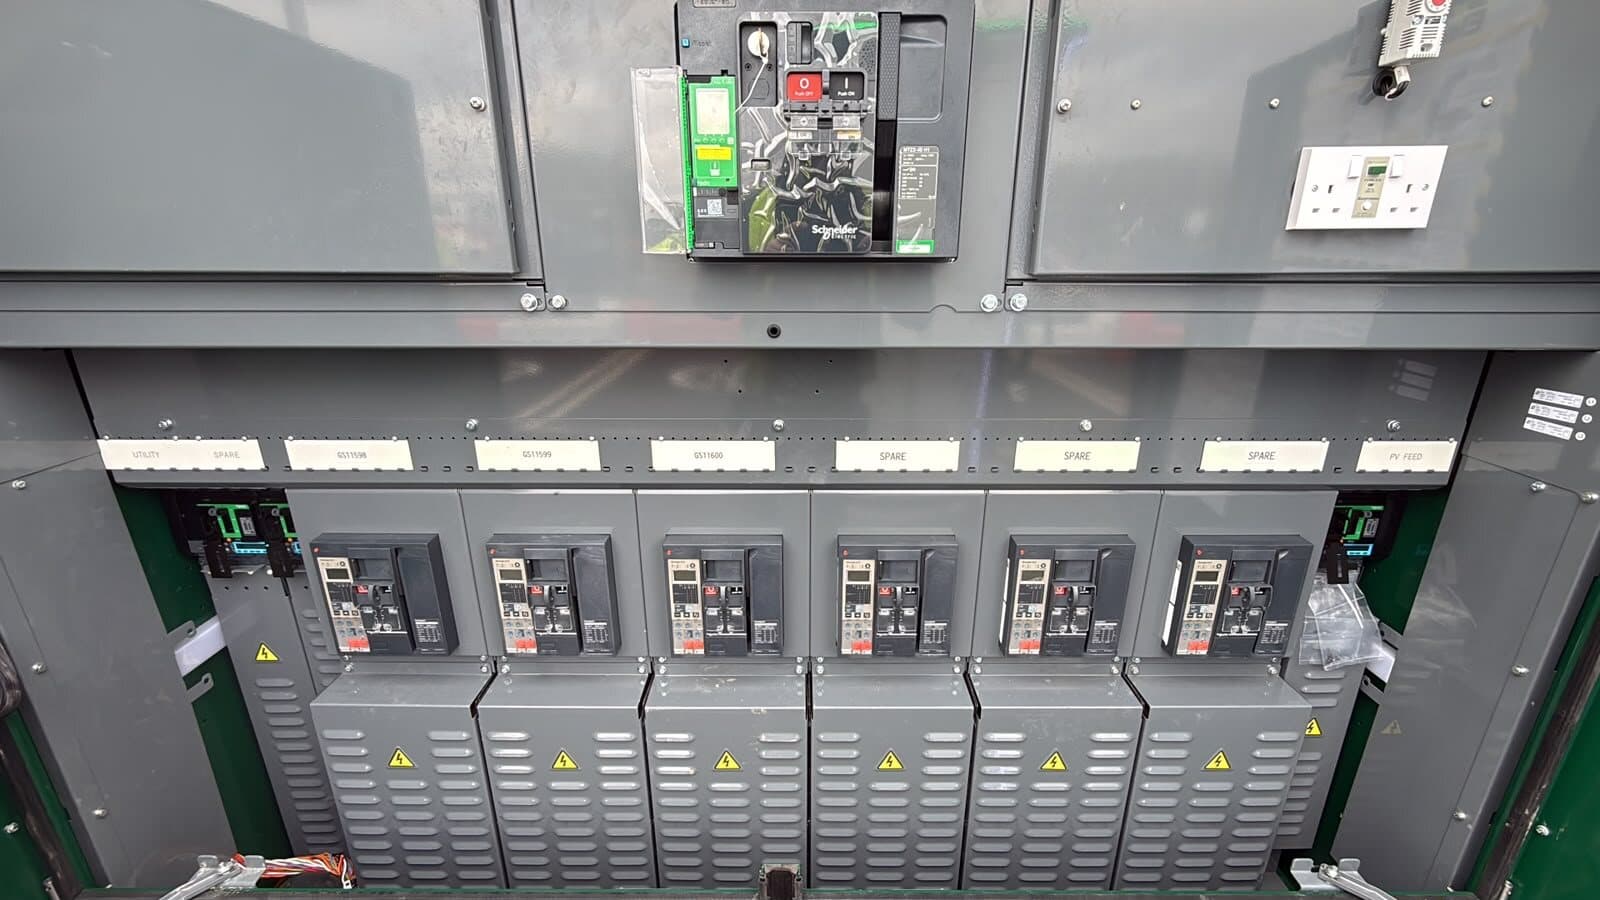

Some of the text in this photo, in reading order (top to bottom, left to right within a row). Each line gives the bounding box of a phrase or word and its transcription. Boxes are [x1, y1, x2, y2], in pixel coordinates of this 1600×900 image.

[811, 224, 858, 240] Schneider
[131, 450, 160, 459] UTILITY
[212, 450, 241, 459] SPARE
[522, 450, 552, 458] GS11599
[693, 451, 724, 460] GS11600
[879, 451, 908, 461] SPARE
[1063, 451, 1092, 461] SPARE
[1247, 451, 1277, 461] SPARE
[1389, 452, 1423, 461] PV FEED
